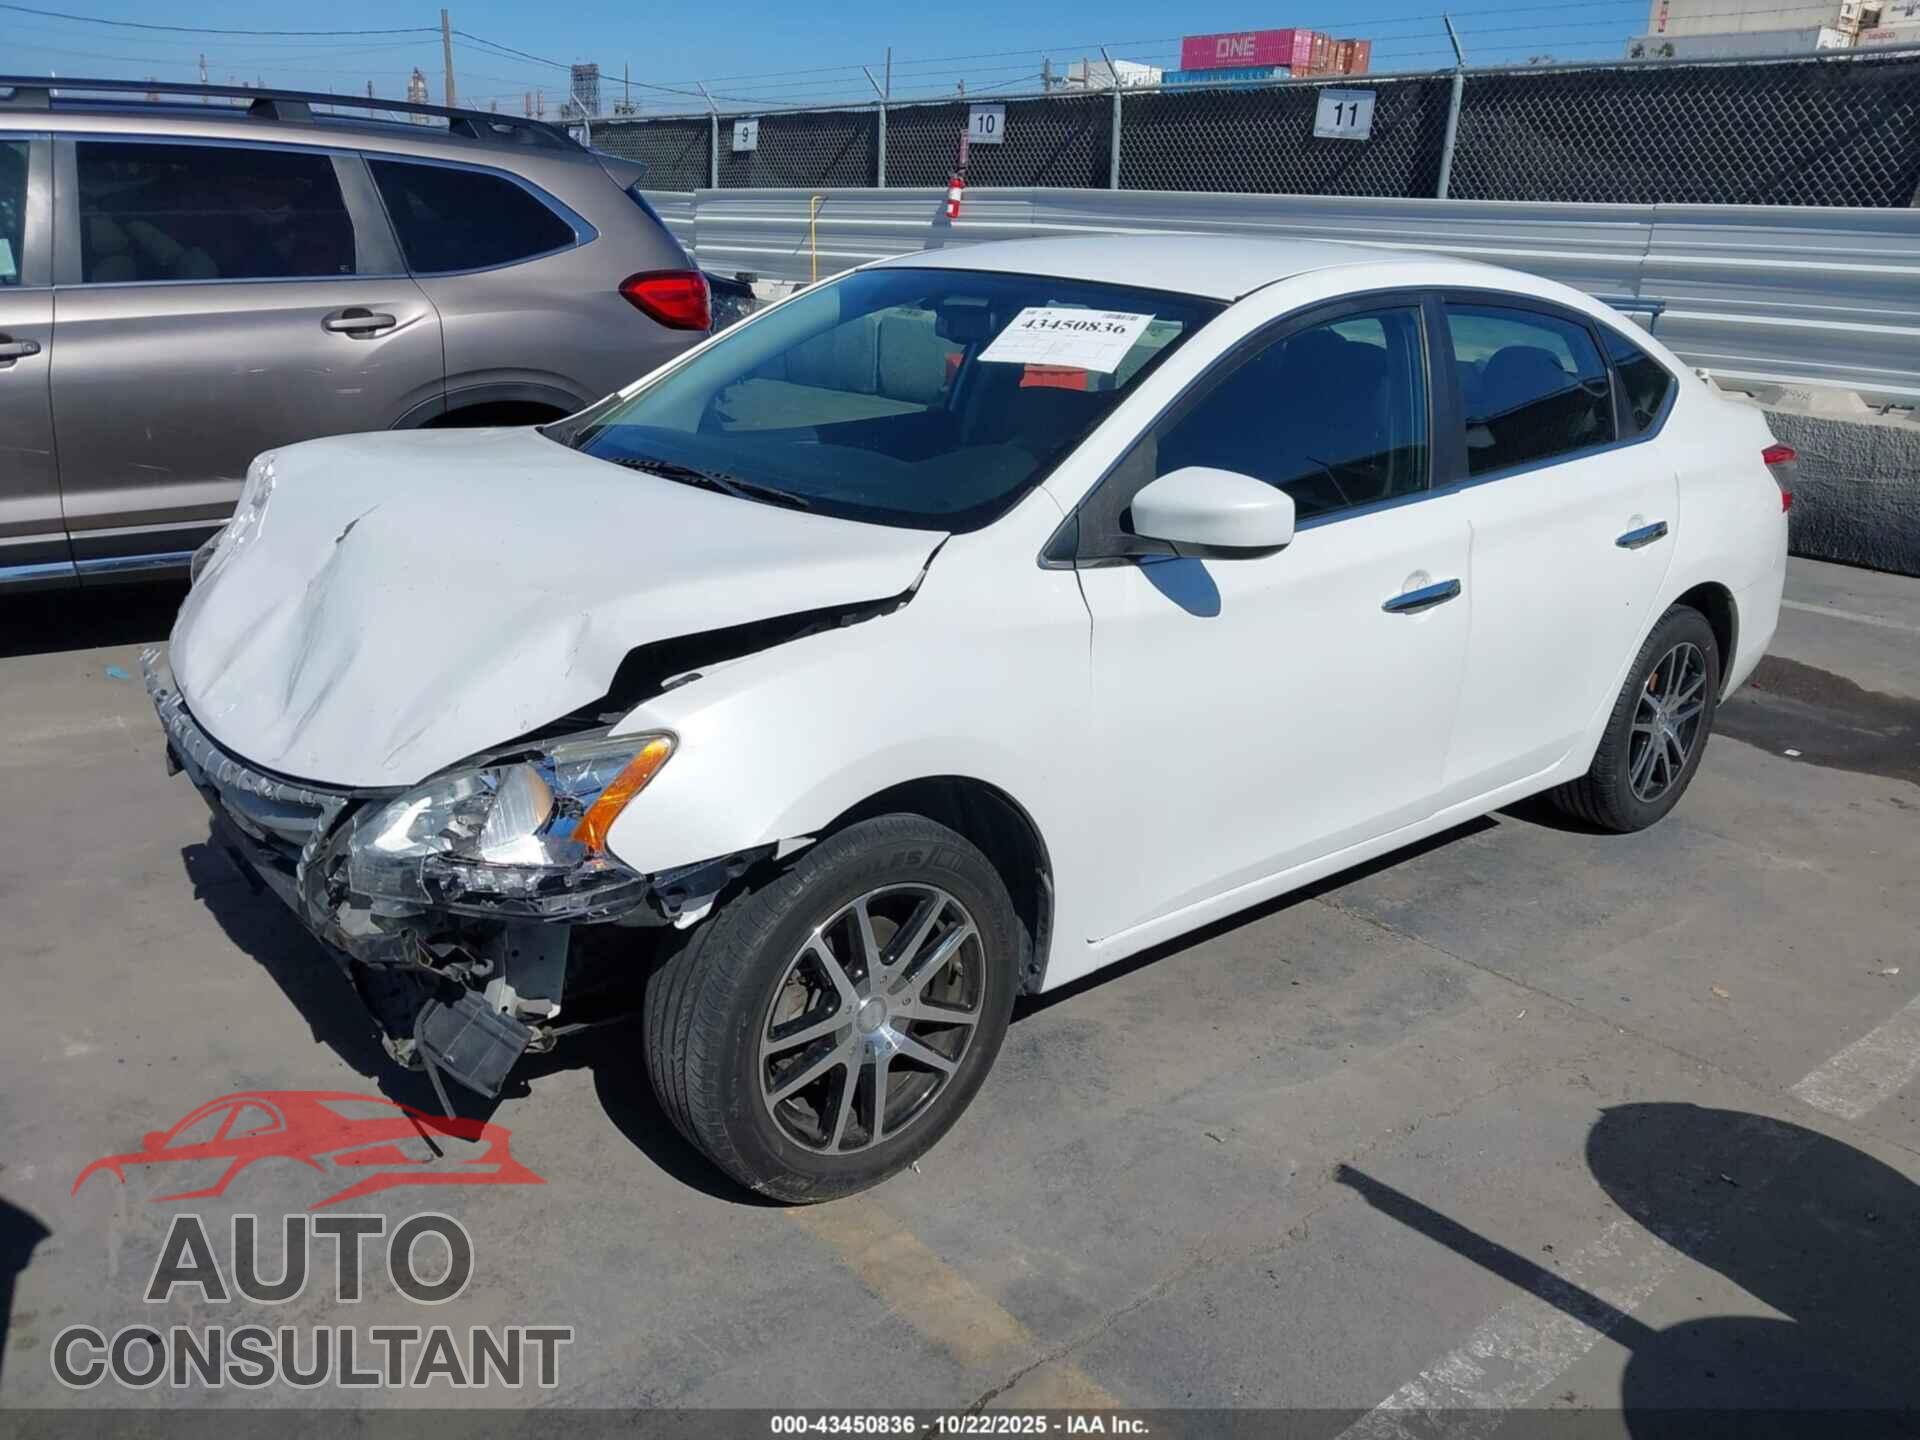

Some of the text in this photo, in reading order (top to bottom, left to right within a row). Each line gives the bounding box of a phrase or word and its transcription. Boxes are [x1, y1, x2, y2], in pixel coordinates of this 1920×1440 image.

[1216, 36, 1256, 57] ONE
[978, 114, 996, 134] 10
[1334, 102, 1358, 128] 11
[741, 126, 750, 143] 9
[1021, 318, 1126, 334] 43450836
